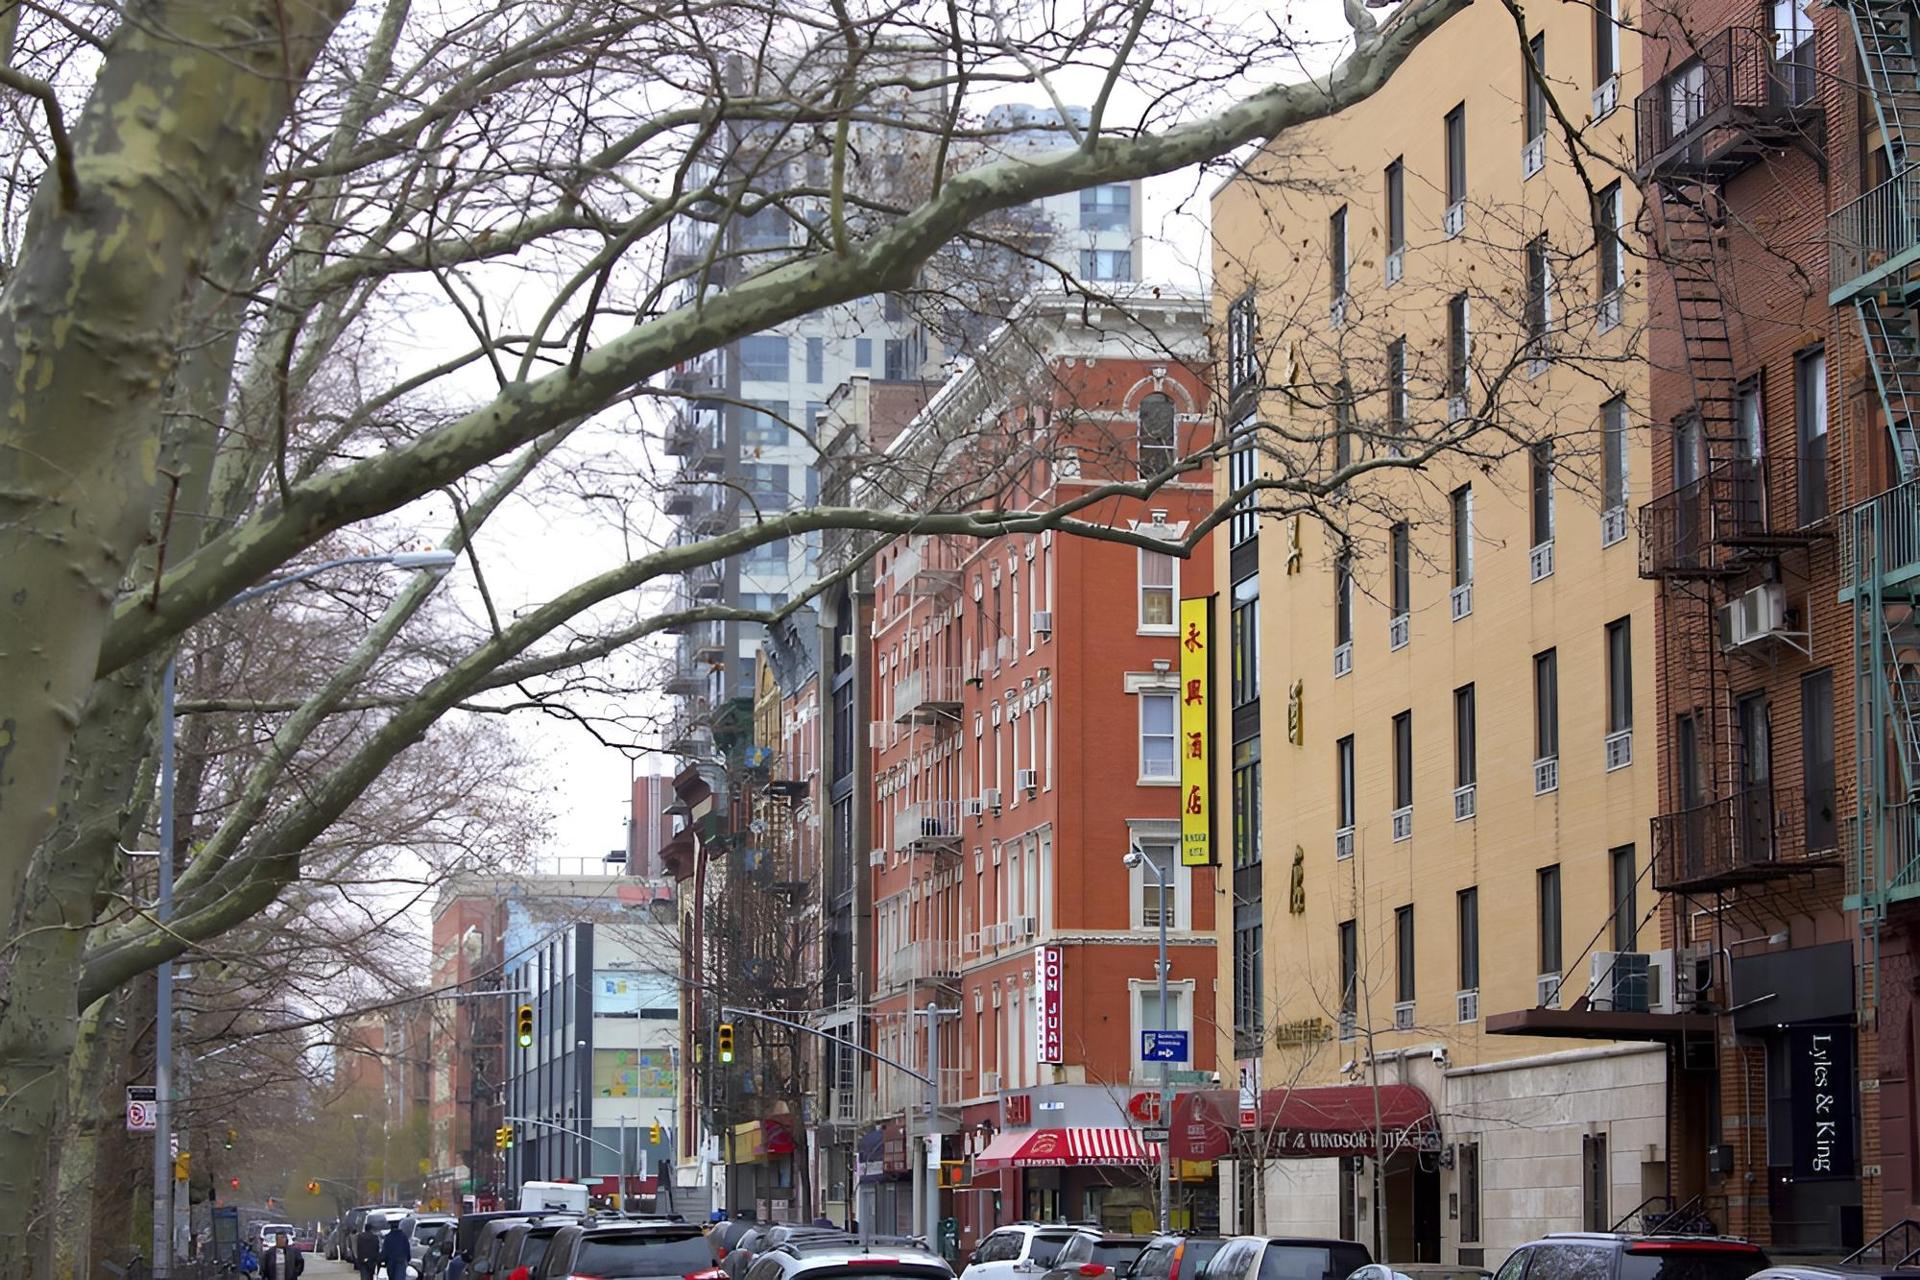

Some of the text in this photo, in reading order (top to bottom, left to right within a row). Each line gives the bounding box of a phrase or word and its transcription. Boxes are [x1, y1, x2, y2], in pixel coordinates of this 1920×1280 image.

[1047, 951, 1058, 1059] DON JUAN
[1309, 1132, 1367, 1149] WINDSOR
[1809, 1034, 1835, 1172] Lyles & King
